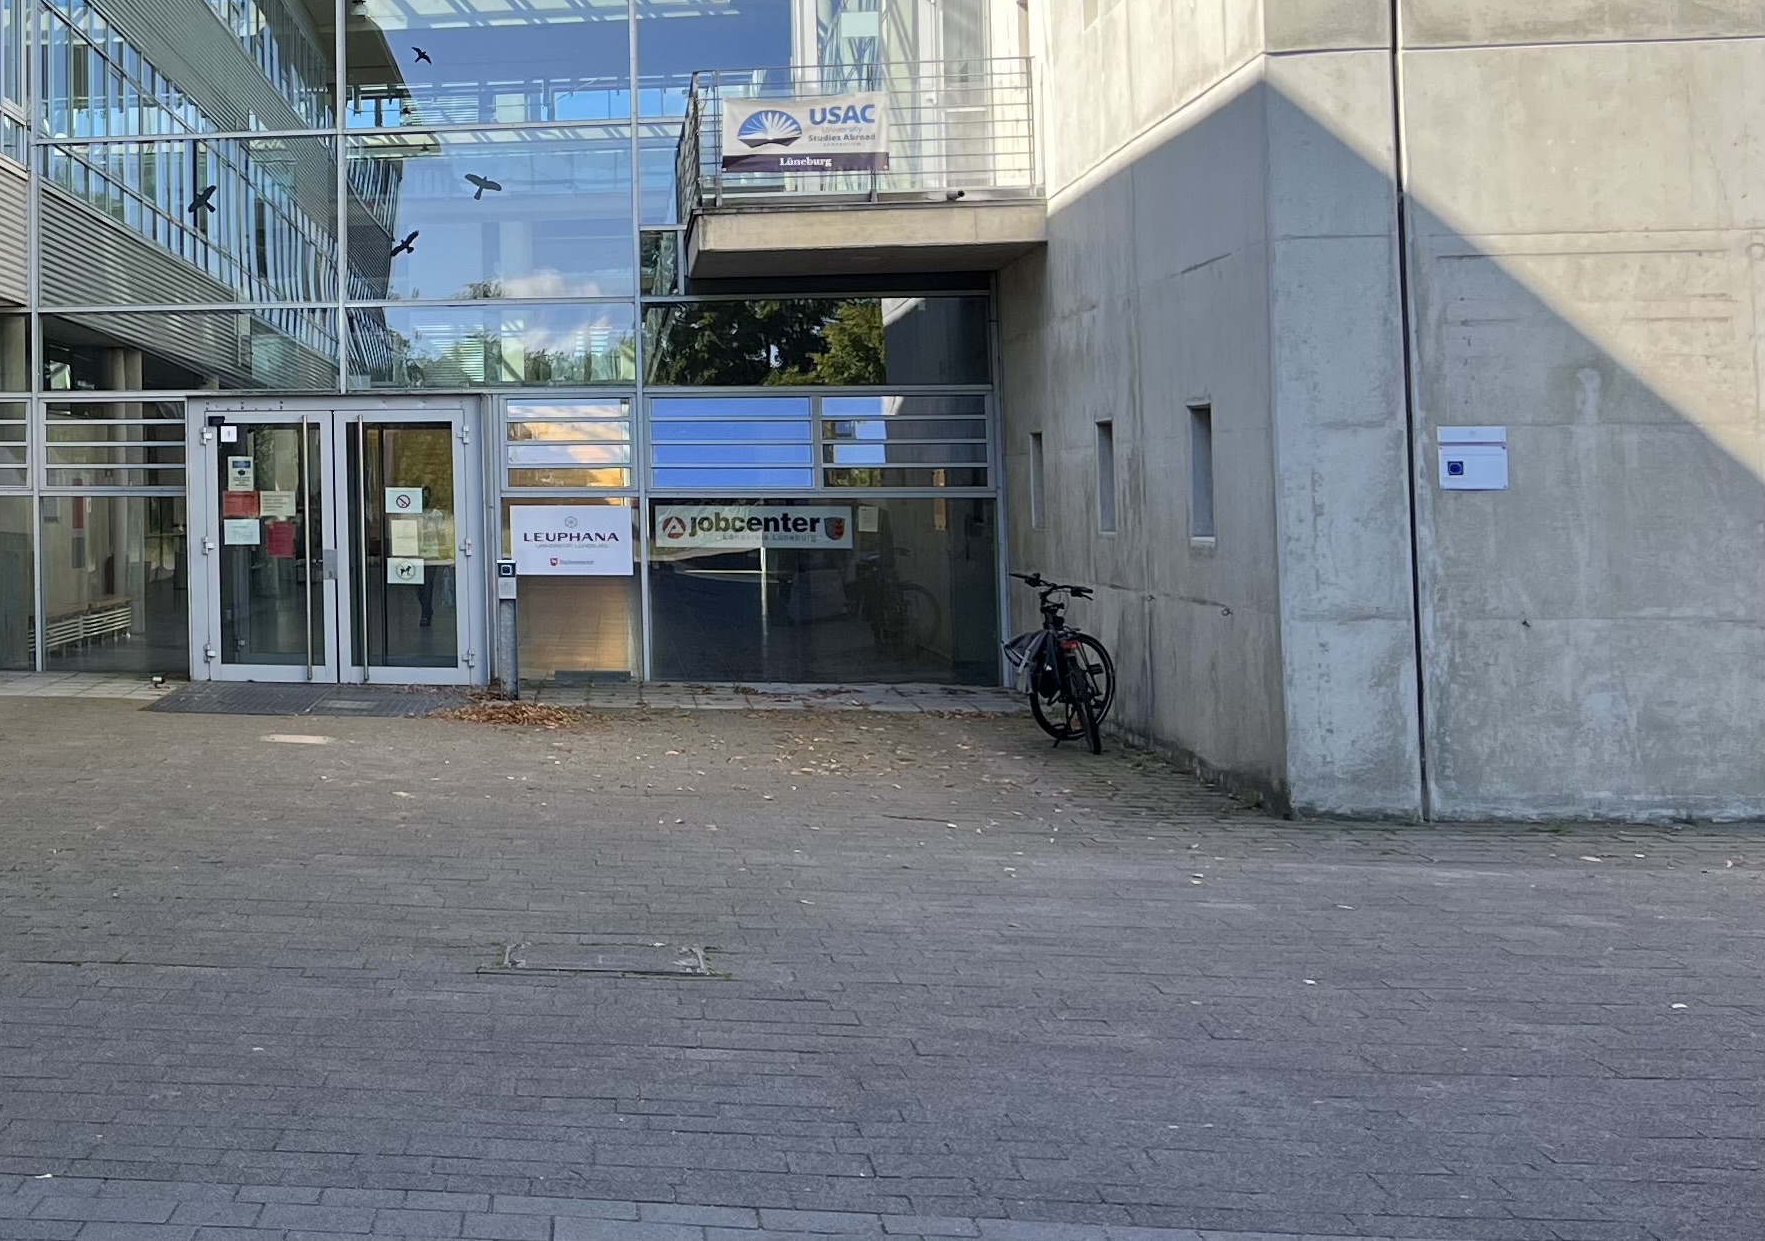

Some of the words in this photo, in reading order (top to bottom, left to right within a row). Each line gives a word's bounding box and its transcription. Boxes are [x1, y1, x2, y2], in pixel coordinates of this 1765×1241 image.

[809, 103, 876, 126] USAC
[808, 134, 842, 142] Studies
[843, 133, 876, 141] Abroad
[779, 156, 833, 168] Lüneburg
[688, 511, 821, 537] jobcenter
[523, 532, 620, 542] LEUPHANA
